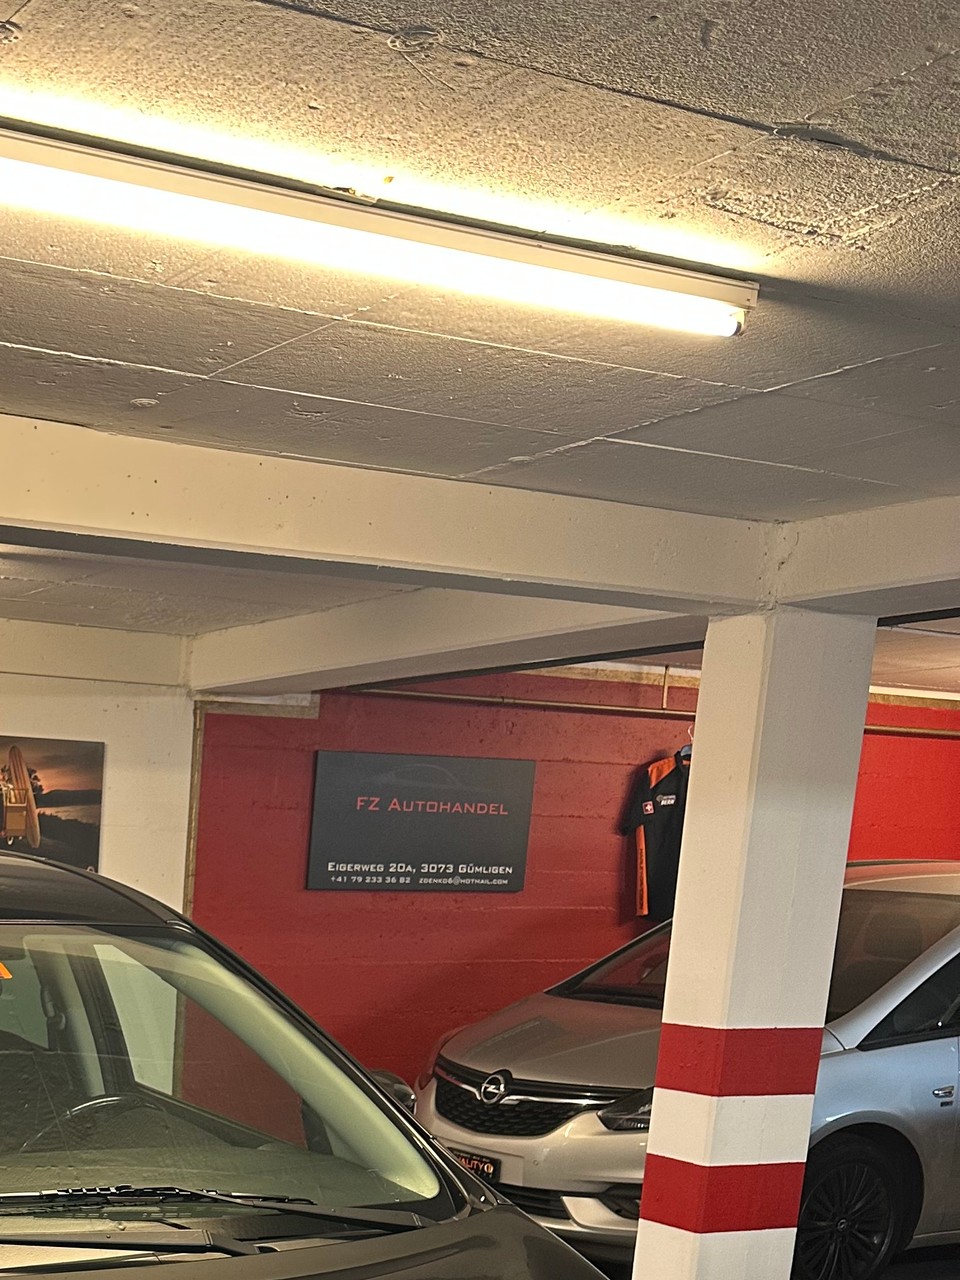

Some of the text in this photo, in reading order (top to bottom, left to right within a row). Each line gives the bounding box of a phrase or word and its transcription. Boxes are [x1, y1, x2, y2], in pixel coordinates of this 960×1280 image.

[356, 796, 509, 815] FZ AUTOHANDEL
[327, 862, 384, 873] EIGERWEG
[421, 864, 454, 873] 3073
[365, 876, 383, 884] 233
